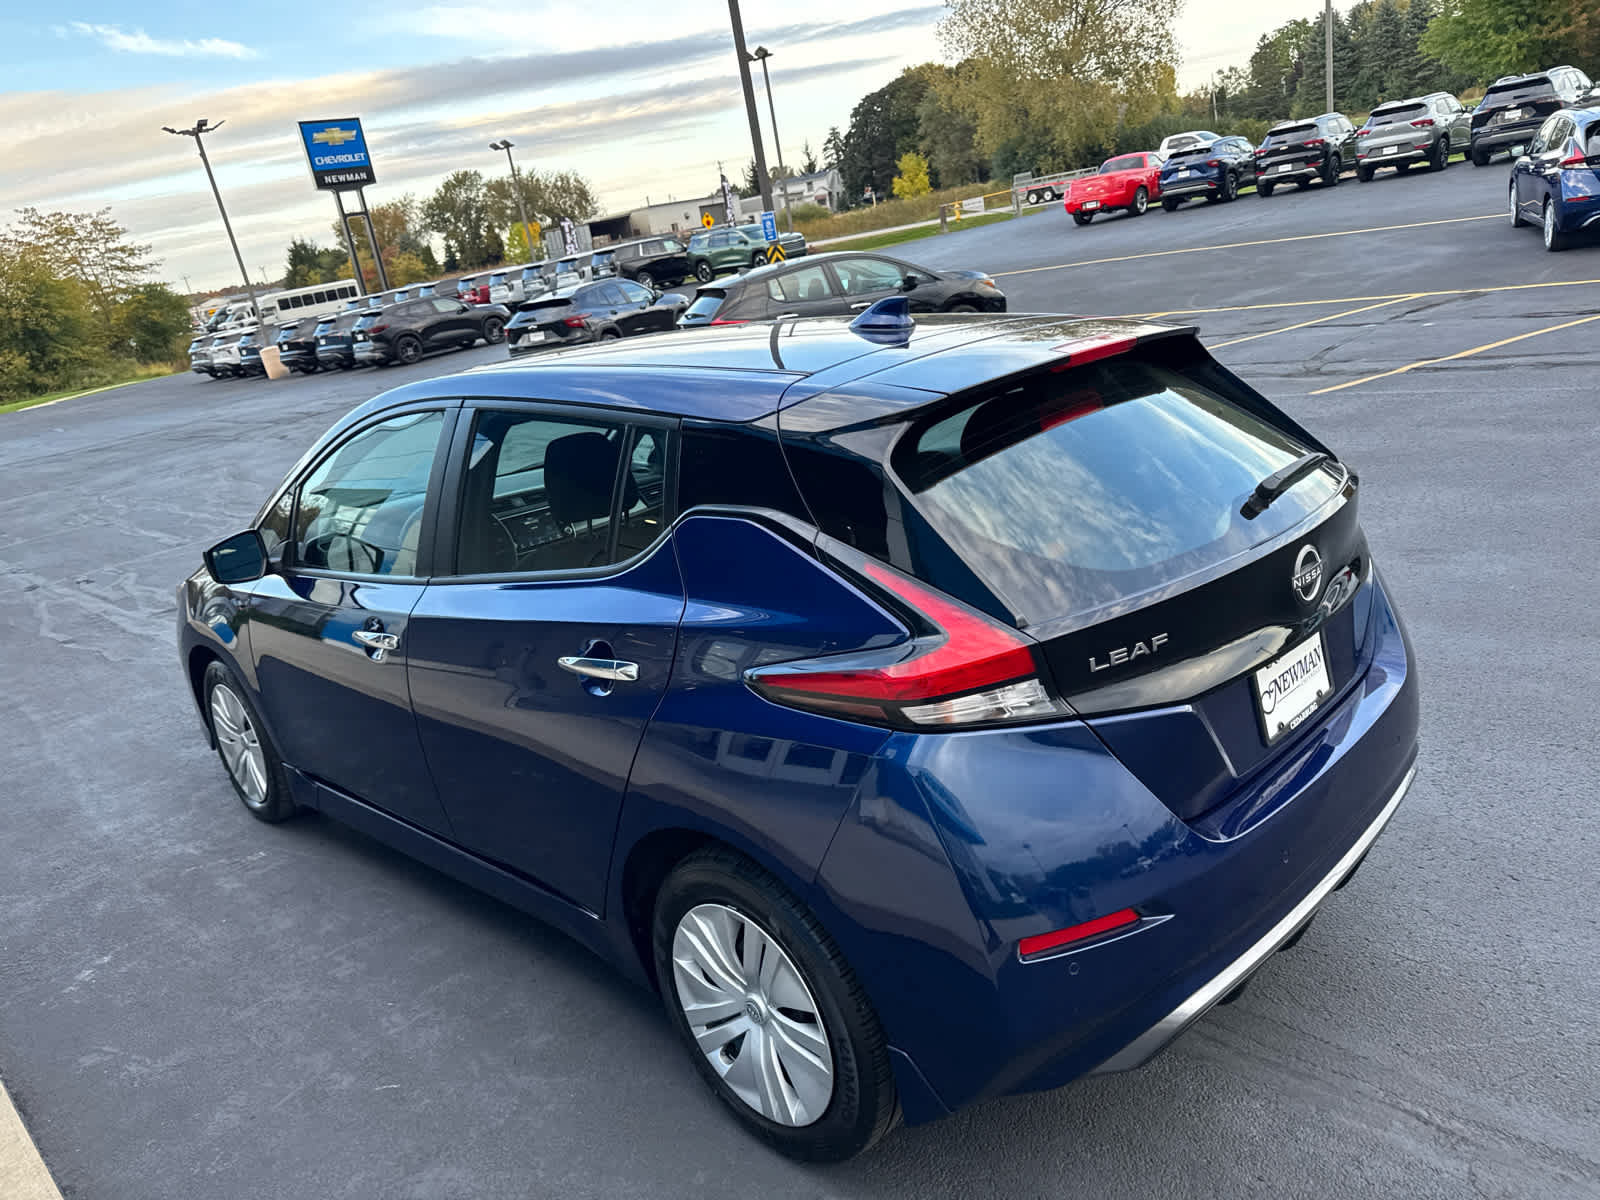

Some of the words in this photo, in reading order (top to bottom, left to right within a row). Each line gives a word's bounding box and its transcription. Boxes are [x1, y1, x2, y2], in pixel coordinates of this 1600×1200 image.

[314, 152, 365, 165] CHEVROLET
[323, 172, 367, 183] NEWMAN
[1293, 565, 1321, 590] NISSA
[1088, 632, 1168, 672] LEAF
[1261, 644, 1322, 715] NEWMAN
